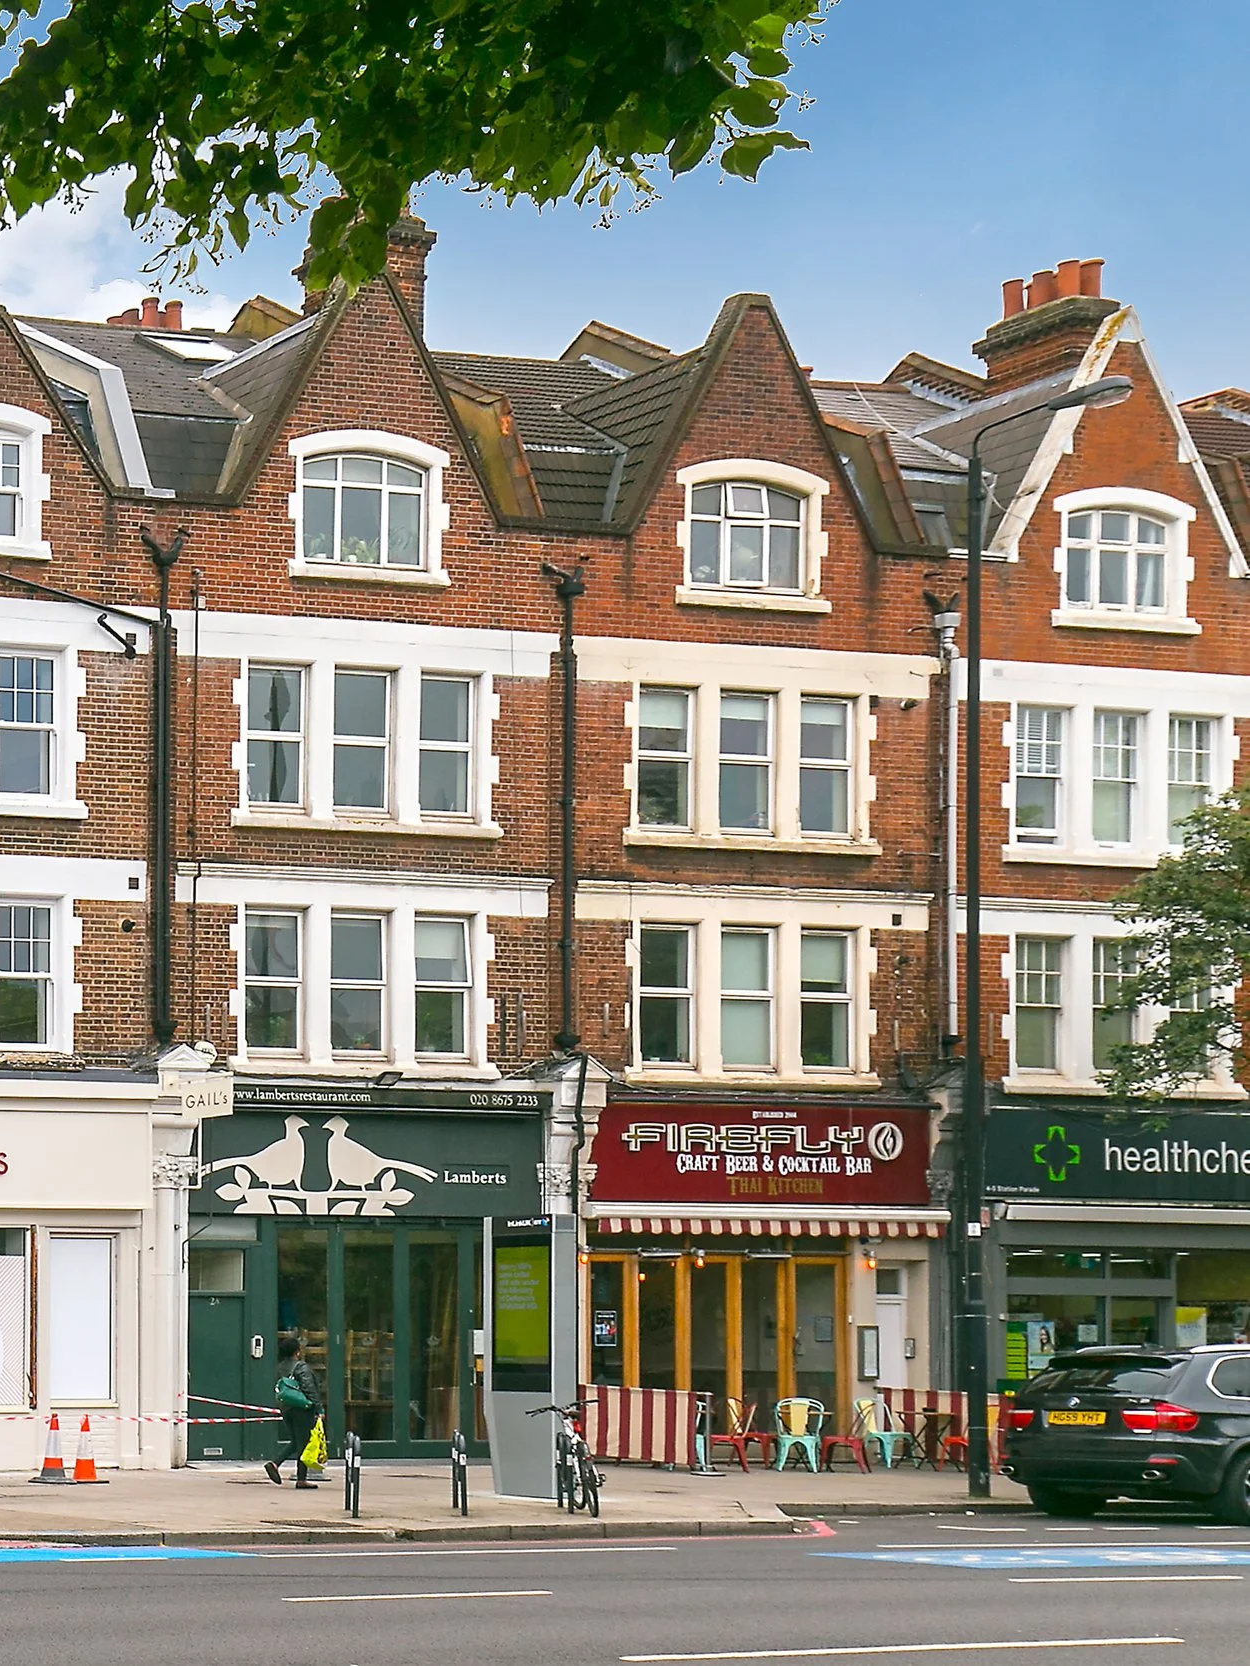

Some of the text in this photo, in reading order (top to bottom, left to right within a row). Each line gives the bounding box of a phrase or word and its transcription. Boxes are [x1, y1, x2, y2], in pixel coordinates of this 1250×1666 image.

[185, 1092, 229, 1109] GAIL's
[469, 1094, 539, 1107] 020 8675 2233
[621, 1122, 865, 1155] FIREFLY
[675, 1153, 872, 1177] CRAFT BEER & COCKTAIL BAR
[443, 1170, 507, 1185] Lamberts
[725, 1176, 824, 1196] THAI KITCHEN
[1052, 1412, 1102, 1422] HG59 YHT
